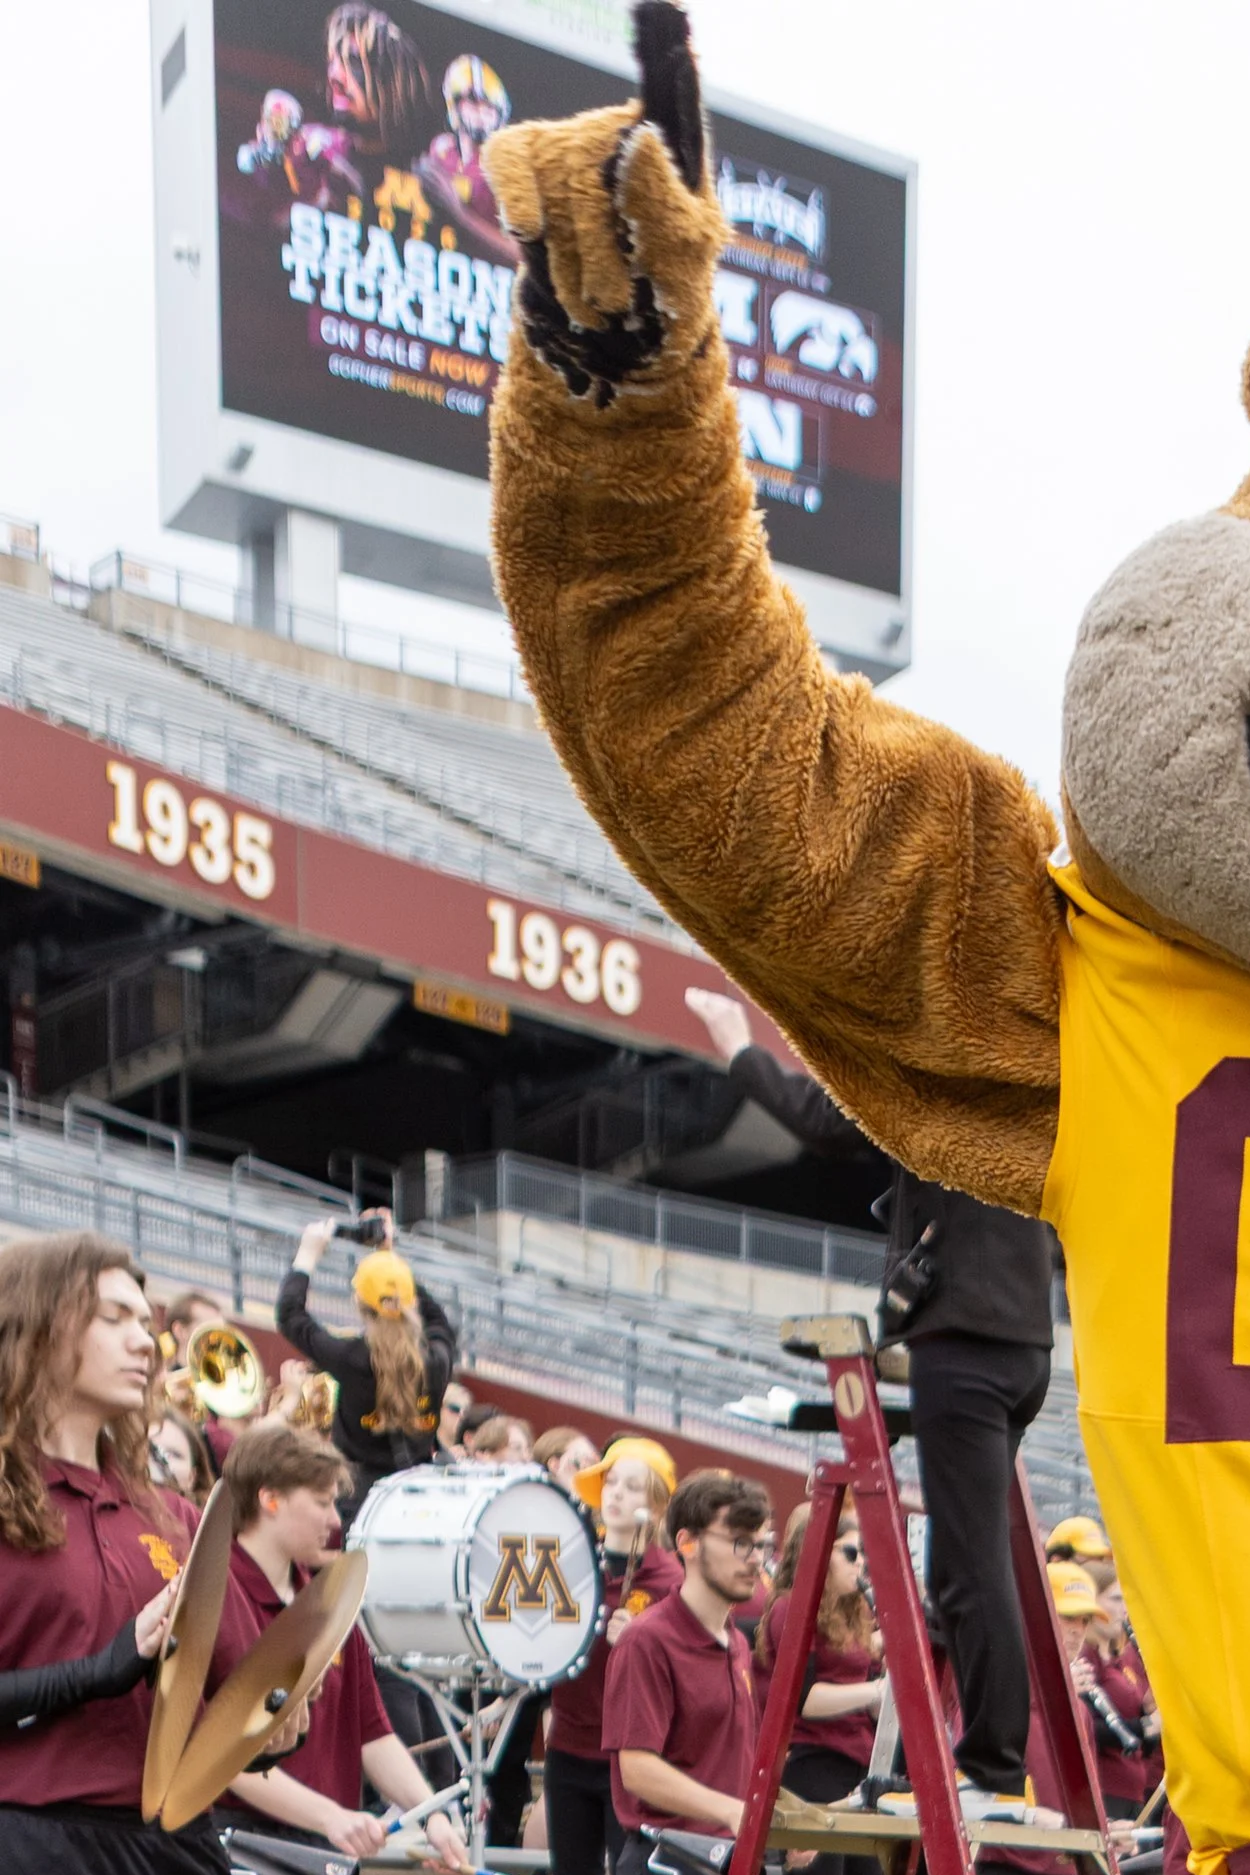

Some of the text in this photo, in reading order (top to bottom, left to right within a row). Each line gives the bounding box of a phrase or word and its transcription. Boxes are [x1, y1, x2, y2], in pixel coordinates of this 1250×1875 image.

[374, 165, 432, 223] M
[281, 243, 514, 365] TICKETS
[290, 201, 516, 318] SEASON
[320, 315, 491, 388] ON SALE NOW
[106, 760, 276, 899] 1935
[487, 899, 642, 1016] 1936
[481, 1532, 580, 1623] M
